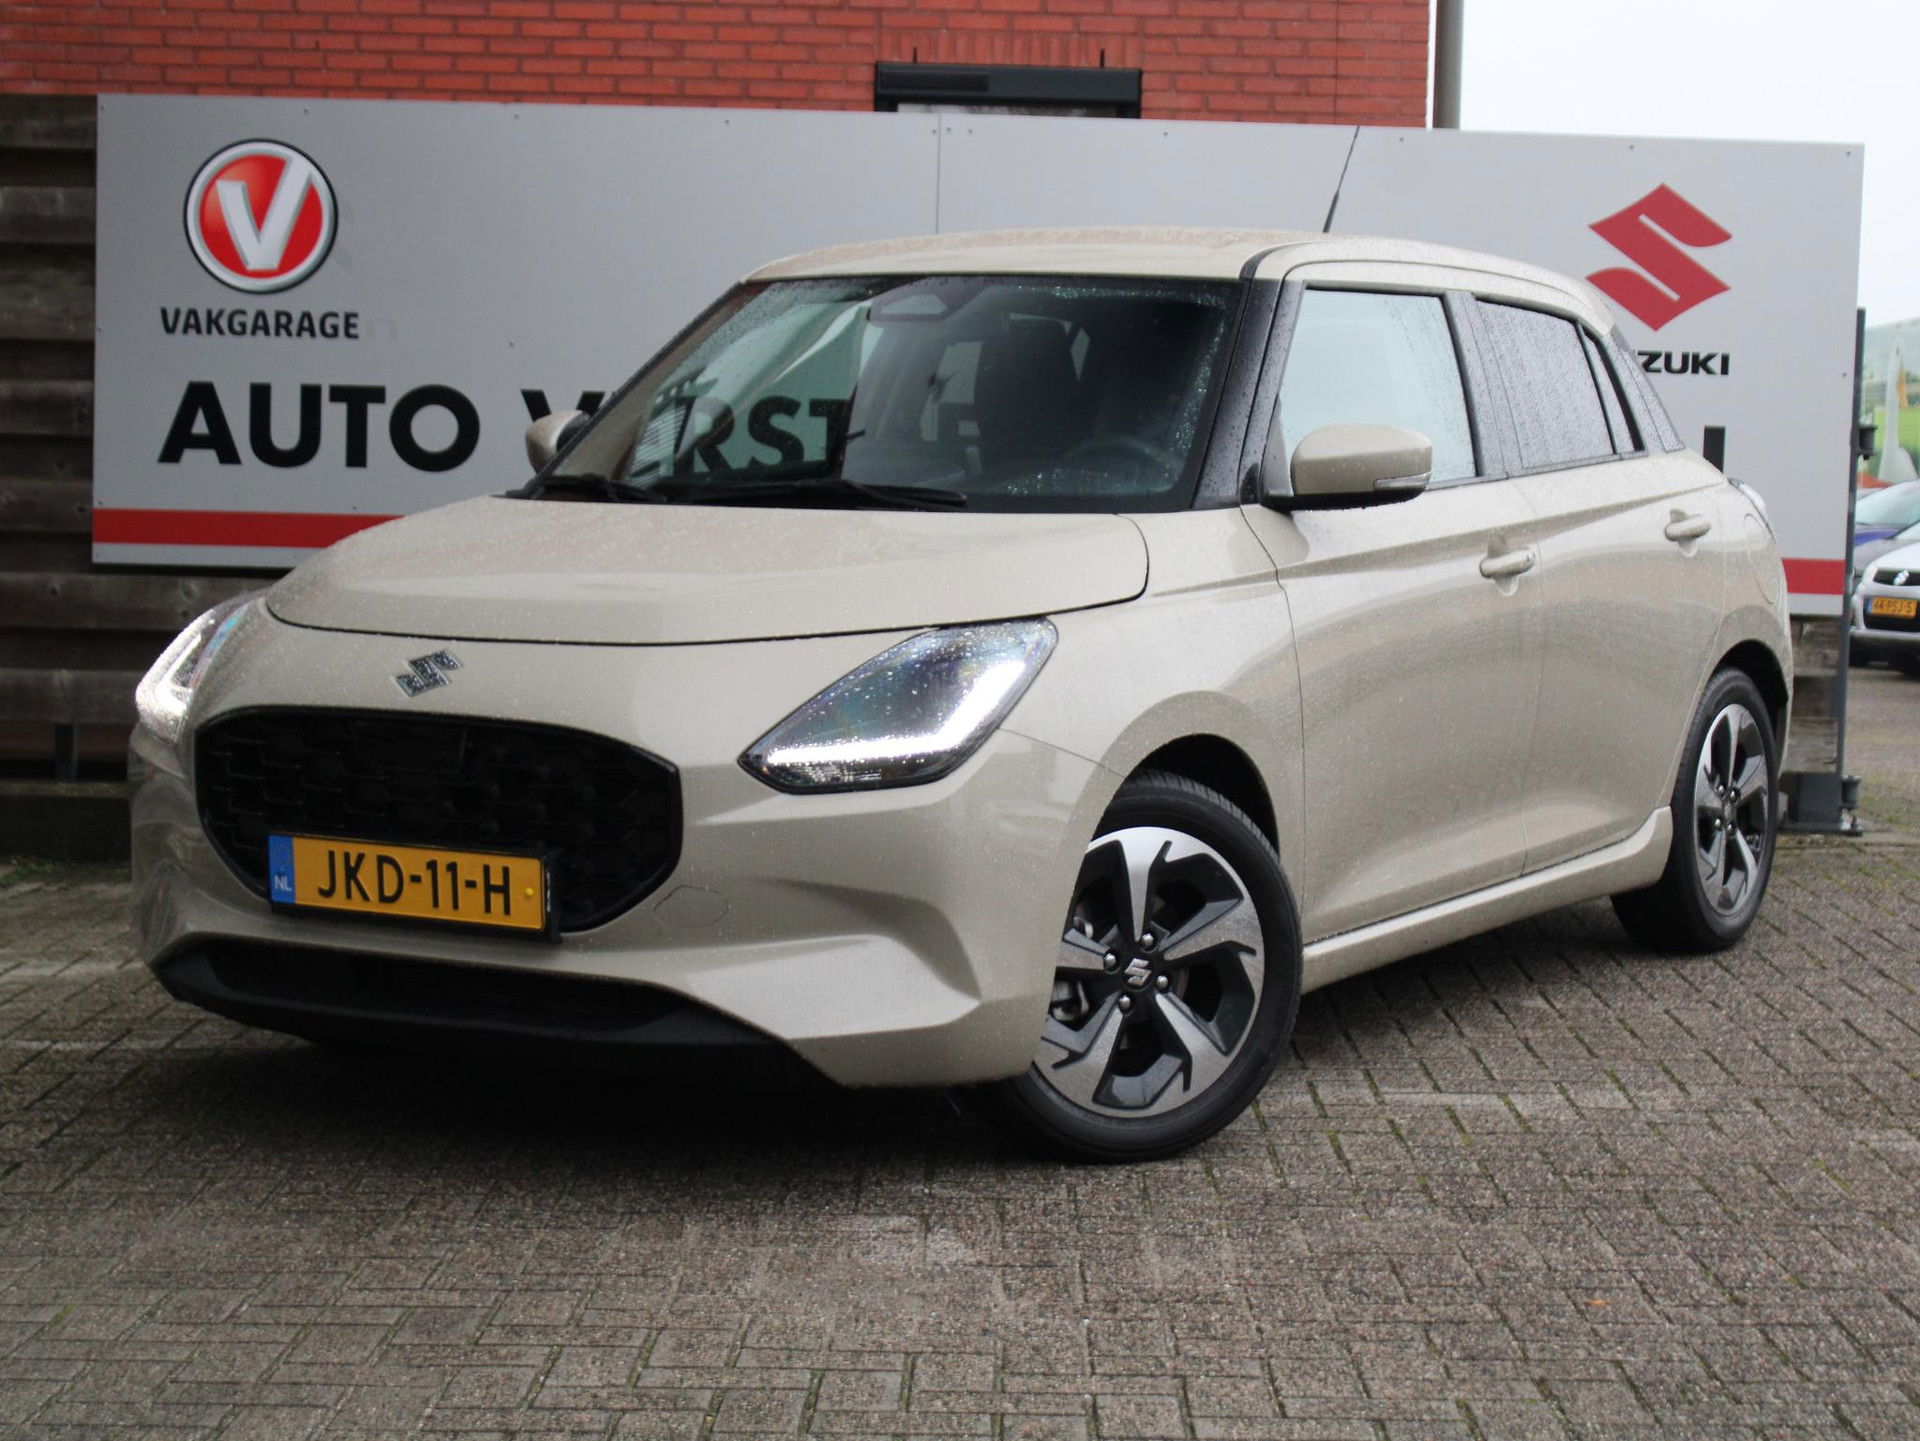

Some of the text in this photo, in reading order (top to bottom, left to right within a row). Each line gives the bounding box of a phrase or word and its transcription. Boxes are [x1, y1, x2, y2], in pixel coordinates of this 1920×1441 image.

[160, 307, 360, 340] VAKGARAGE
[1637, 350, 1730, 375] ZUKI
[157, 380, 481, 473] AUTO
[274, 874, 293, 892] NL
[317, 850, 512, 916] JKD-11-H
